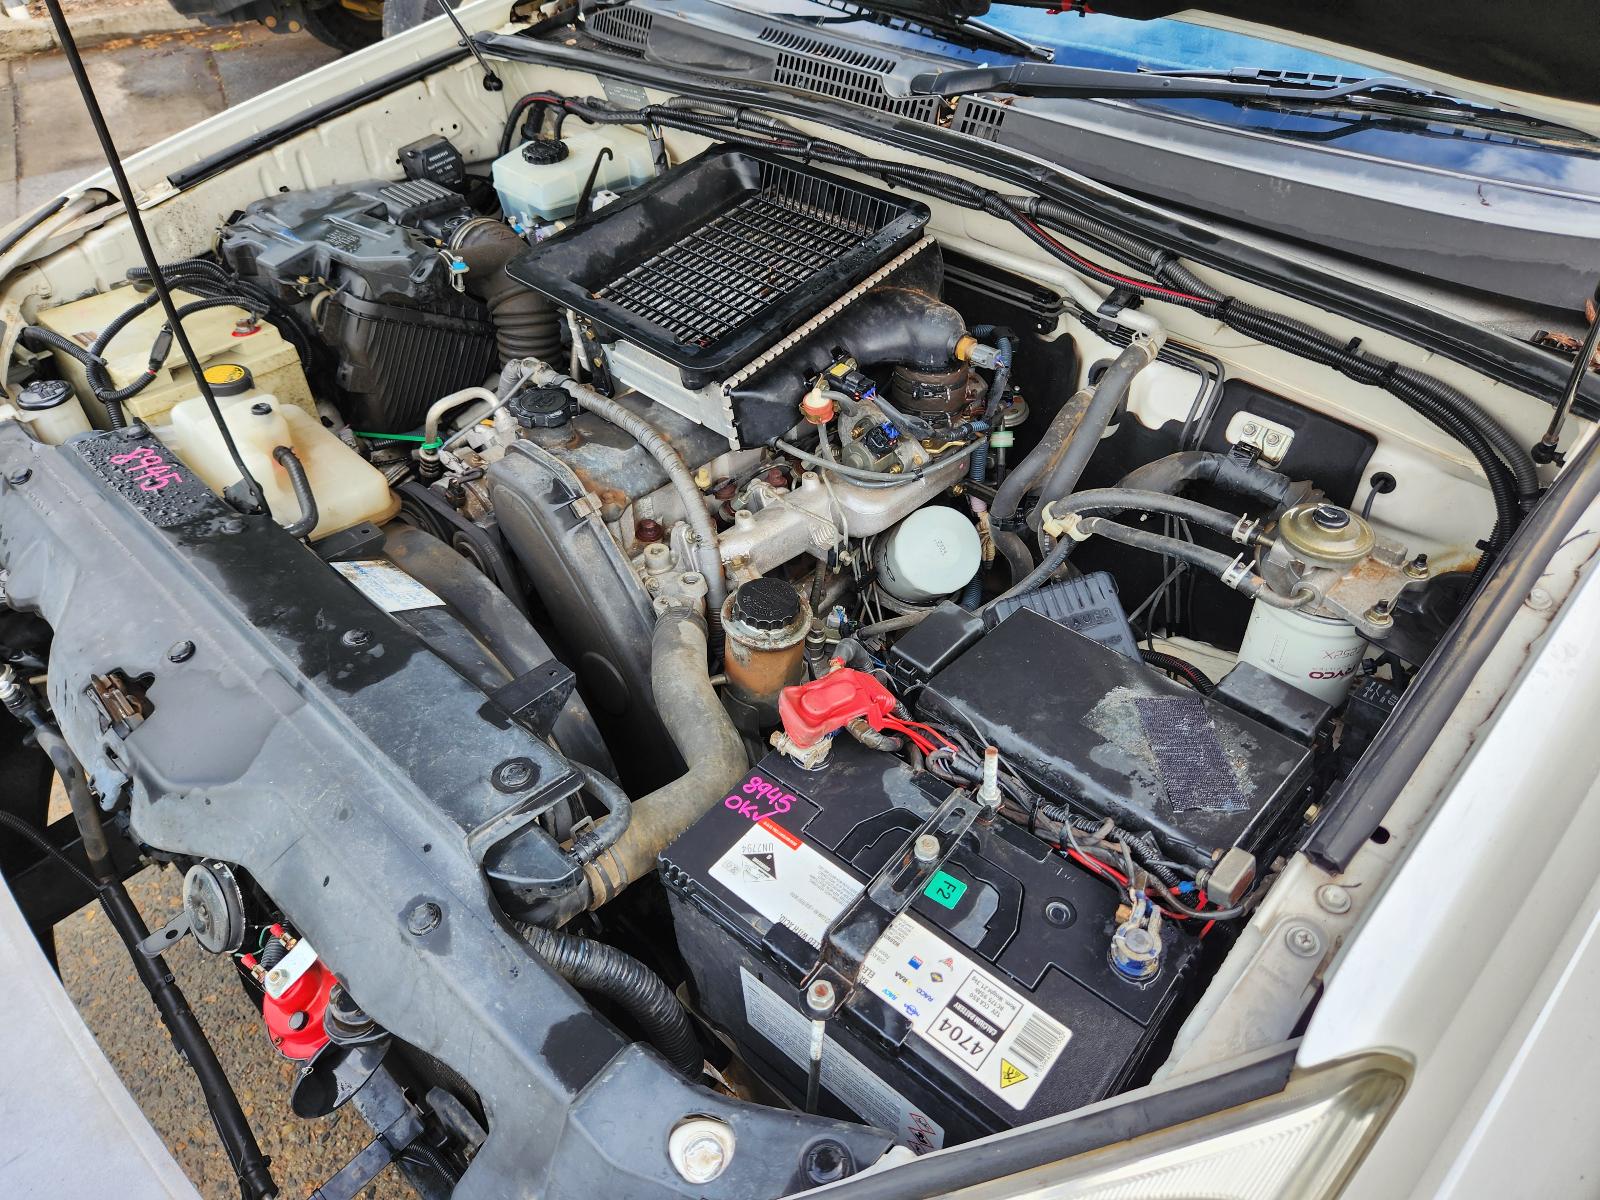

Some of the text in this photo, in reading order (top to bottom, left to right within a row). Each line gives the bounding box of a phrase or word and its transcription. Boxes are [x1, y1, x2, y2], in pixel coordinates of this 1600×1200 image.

[111, 448, 183, 492] 8945
[1309, 662, 1356, 680] RYCO
[743, 776, 797, 813] 8945
[936, 880, 957, 900] F2
[936, 1016, 986, 1058] 4704
[952, 1000, 998, 1037] CALCIUM BATTERY
